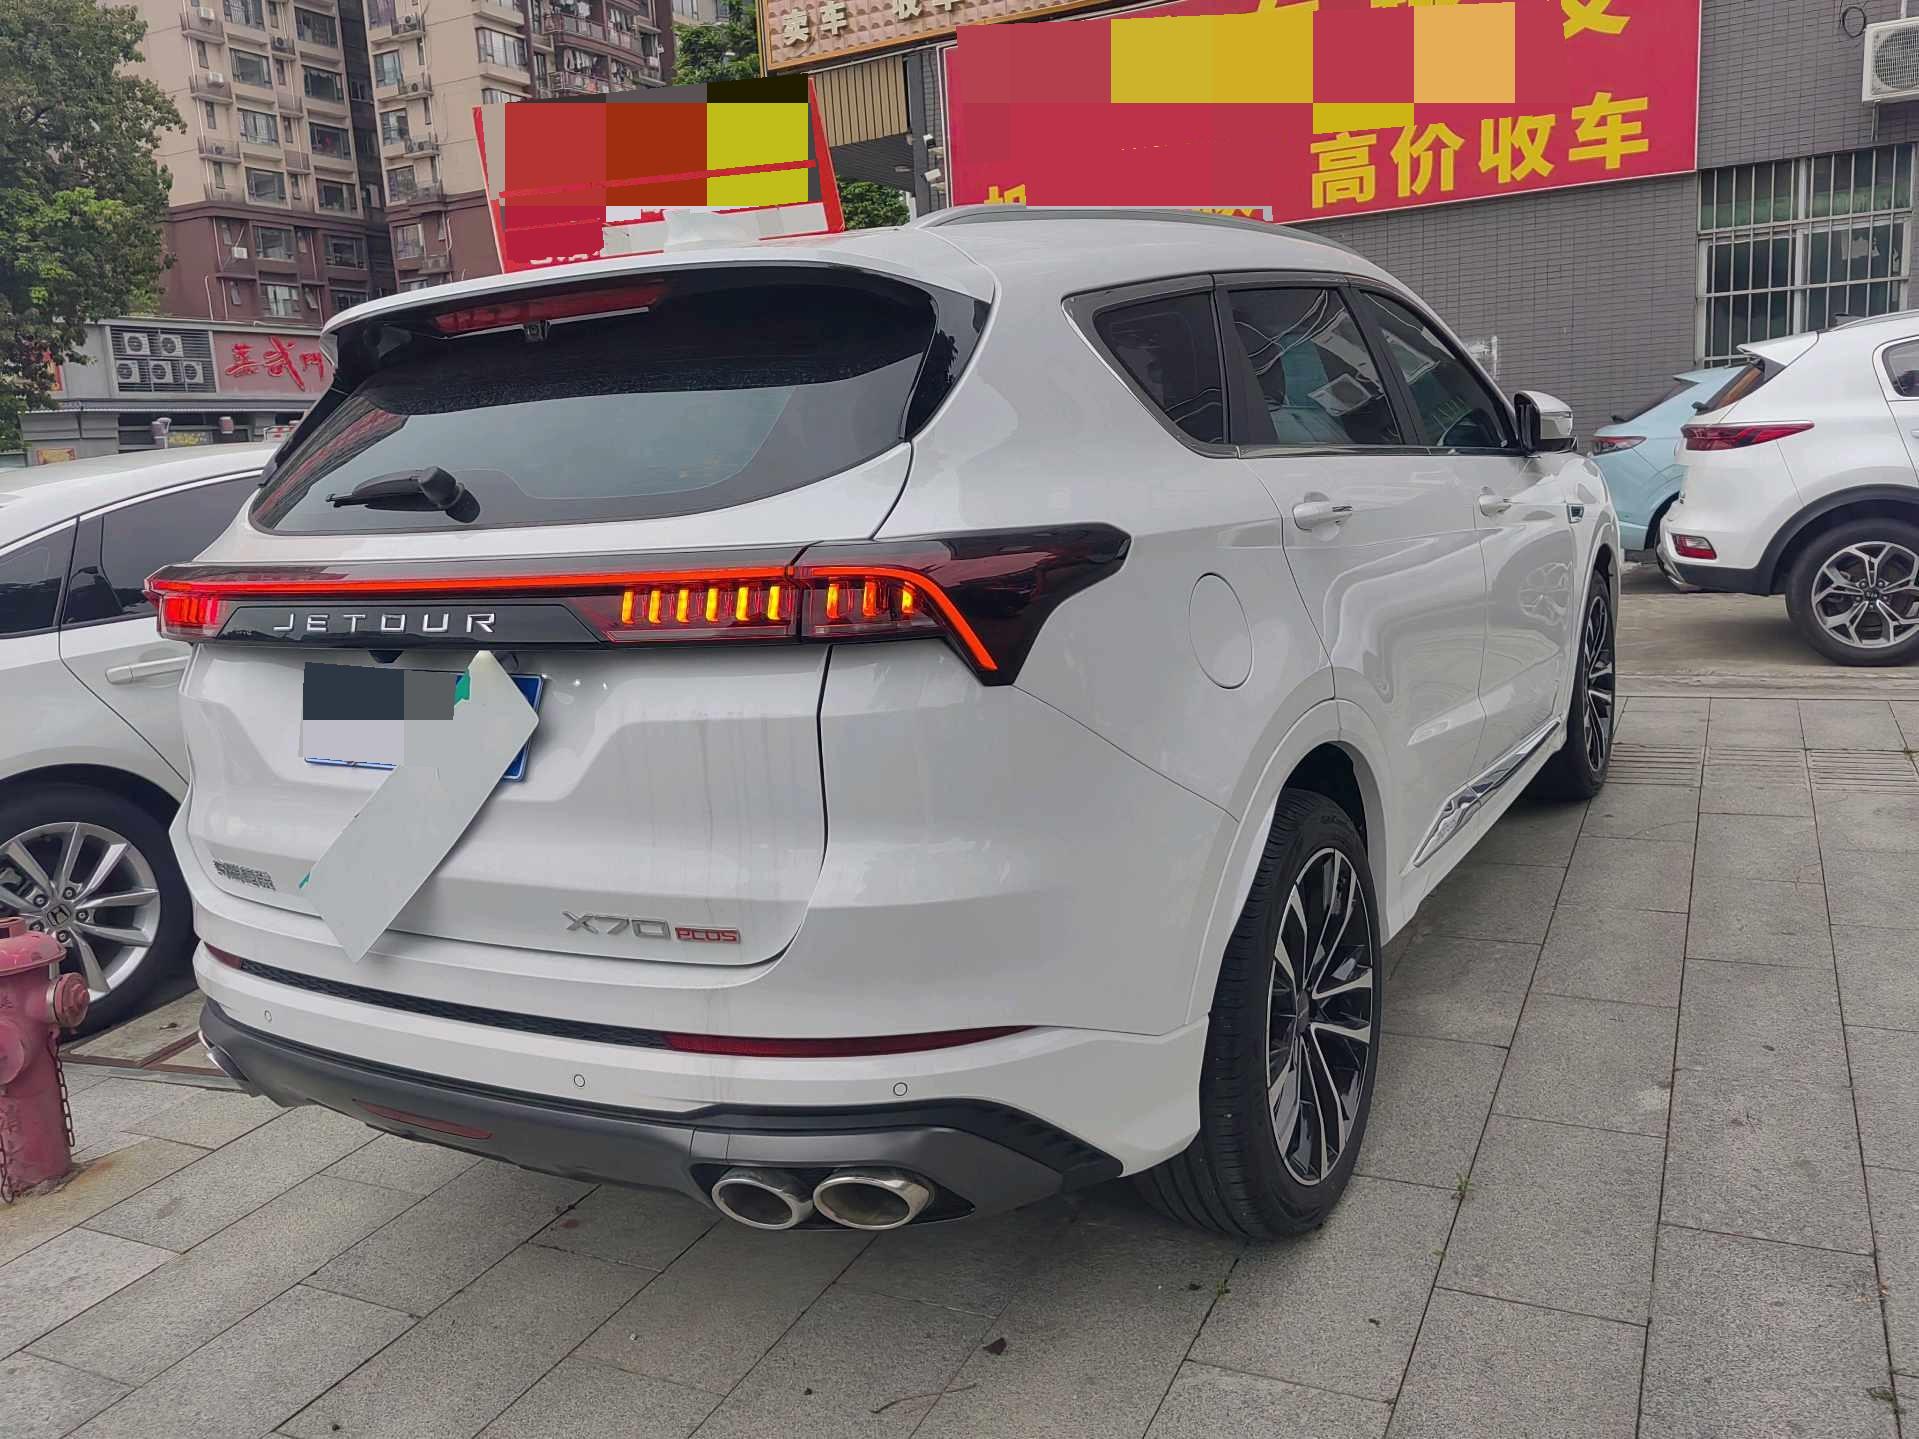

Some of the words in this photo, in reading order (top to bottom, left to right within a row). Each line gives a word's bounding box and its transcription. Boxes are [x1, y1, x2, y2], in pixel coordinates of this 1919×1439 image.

[783, 0, 848, 46] 卖车
[1310, 92, 1648, 209] 高价收车
[273, 612, 496, 634] JETOUR
[561, 910, 671, 940] X70
